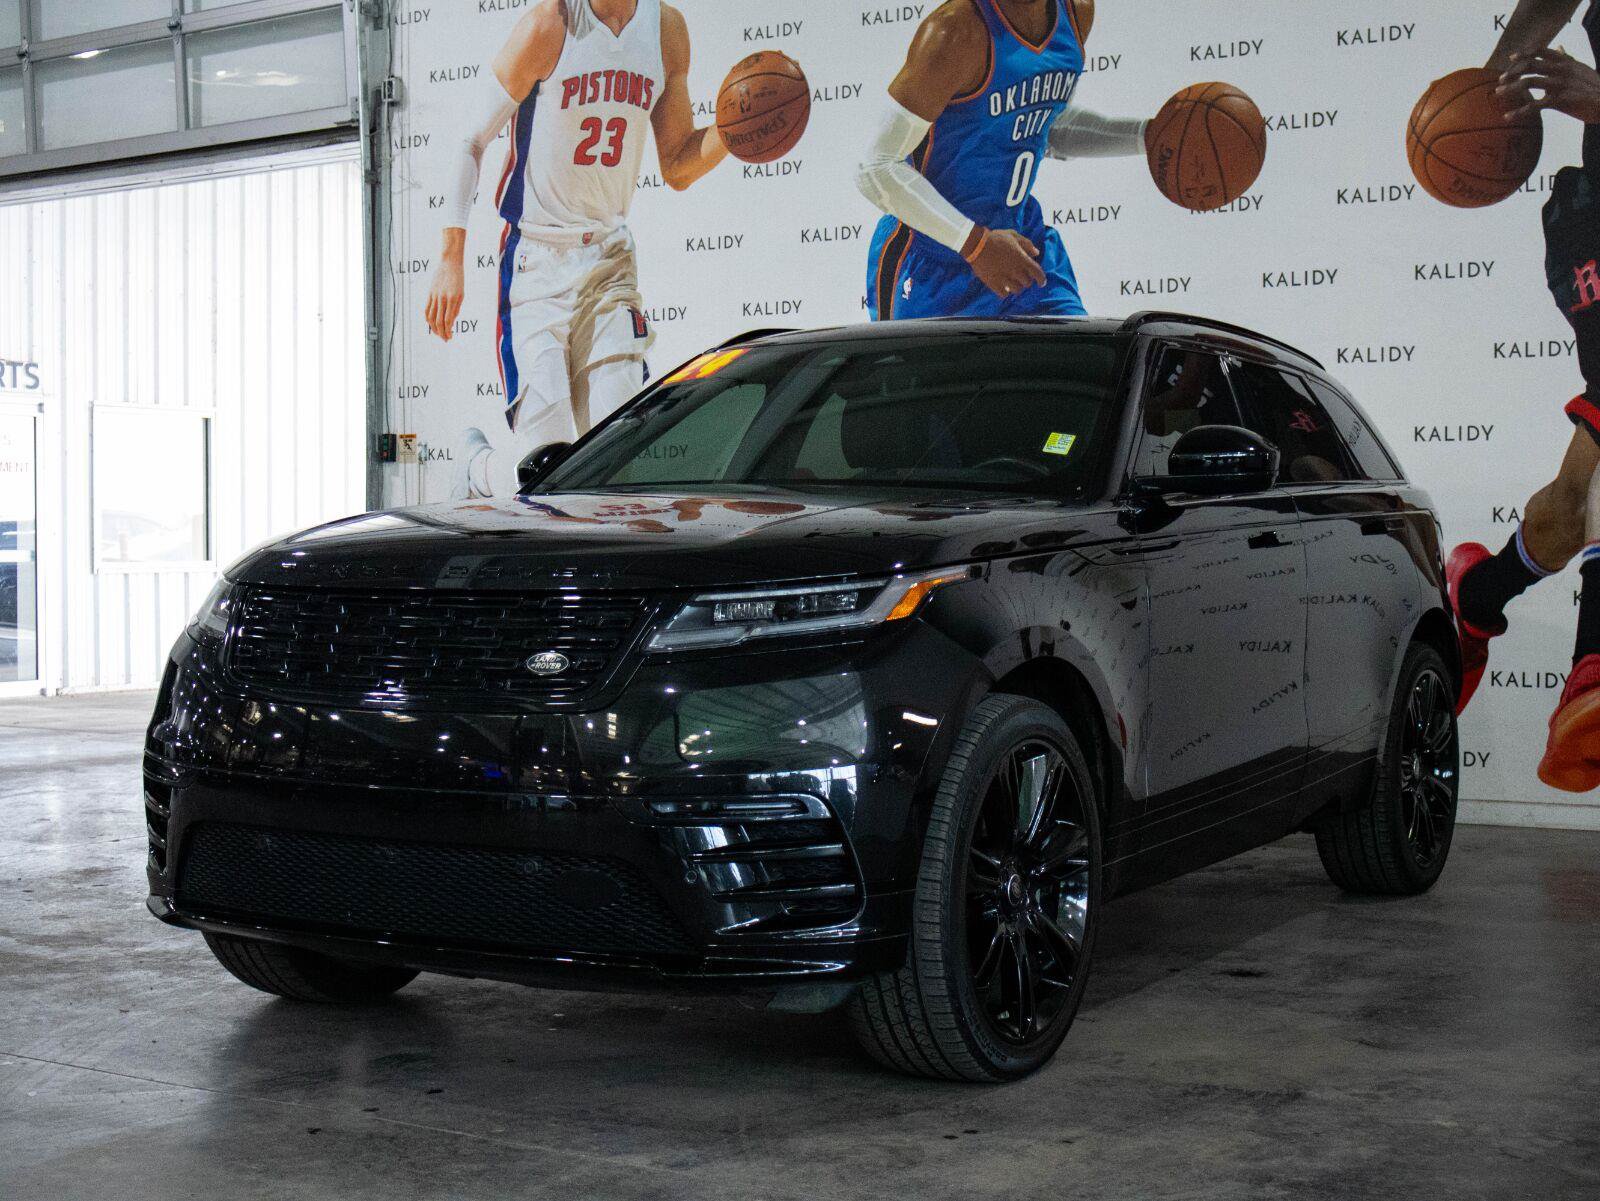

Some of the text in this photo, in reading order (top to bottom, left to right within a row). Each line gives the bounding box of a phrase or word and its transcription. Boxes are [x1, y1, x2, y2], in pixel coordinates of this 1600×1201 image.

[861, 5, 924, 26] KALIDY
[743, 21, 803, 41] KALIDY
[1337, 24, 1415, 46] KALIDY
[1190, 39, 1263, 61] KALIDY
[1082, 55, 1122, 73] IDY
[430, 65, 480, 84] KALIDY
[561, 69, 654, 110] PISTONS
[989, 71, 1077, 117] OKLAHOM
[1011, 108, 1053, 142] CITY
[1265, 110, 1338, 131] KALIDY
[573, 117, 628, 168] 23
[743, 160, 802, 179] KALIDY
[1005, 151, 1034, 207] 0
[1337, 184, 1415, 205] KALIDY
[1053, 206, 1121, 225] KALIDY
[686, 234, 744, 251] KALIDY
[801, 225, 862, 244] KALIDY
[1262, 269, 1338, 288] KALIDY
[1414, 260, 1495, 281] KALIDY
[1121, 277, 1191, 294] KALIDY
[743, 300, 802, 317] KALIDY
[1337, 346, 1415, 363] KALIDY
[1494, 340, 1576, 359] KALIDY
[1414, 424, 1494, 442] KALIDY
[534, 654, 558, 663] LAND
[534, 662, 562, 670] ROVER
